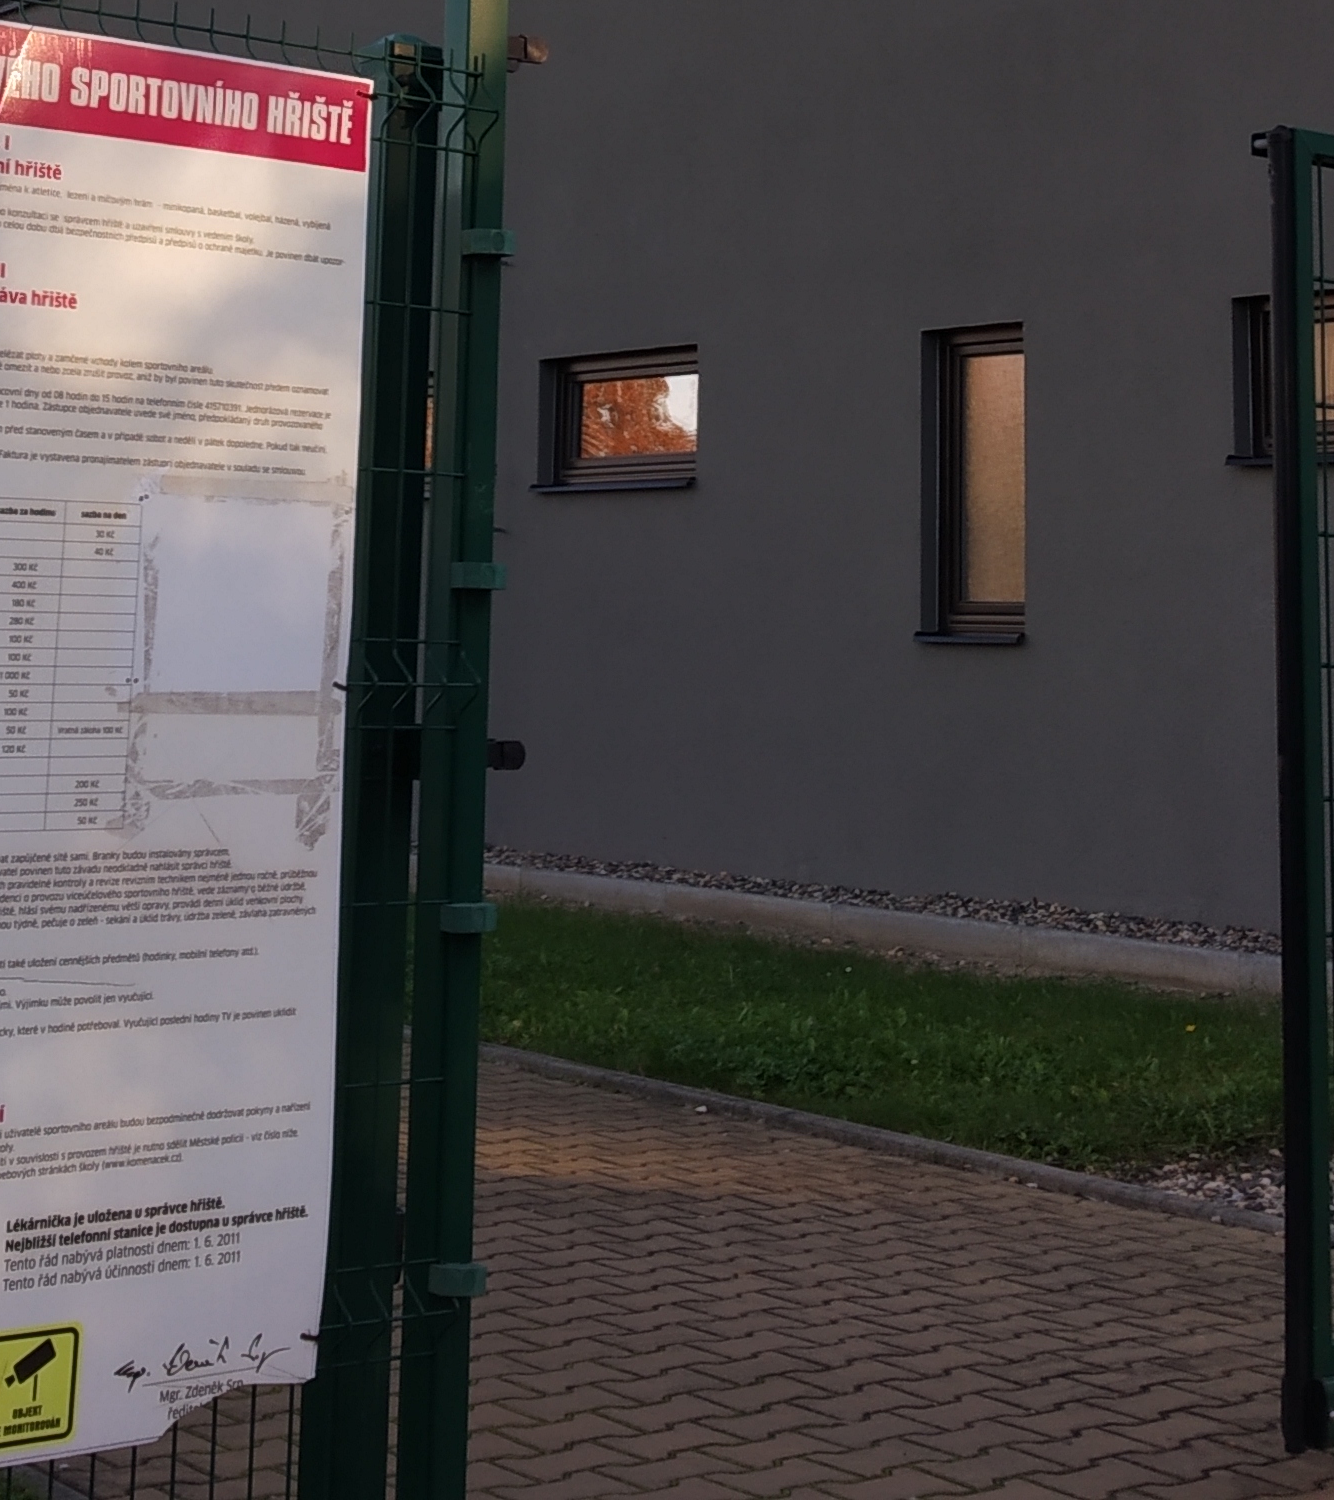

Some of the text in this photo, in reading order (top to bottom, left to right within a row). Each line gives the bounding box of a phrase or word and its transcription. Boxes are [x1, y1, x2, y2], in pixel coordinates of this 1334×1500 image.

[71, 67, 259, 132] SPORTOVNÍHO
[268, 91, 354, 145] HŘIŠTĚ
[4, 134, 10, 150] I
[14, 159, 61, 180] hřiště
[30, 289, 77, 309] hřiště
[4, 1204, 308, 1253] Nejbližší telefonní stanice je dostupna u správce hřiště.
[5, 1195, 225, 1233] Lékárnička je uložena u správce hřiště.
[3, 1231, 239, 1271] Tento řád nabývá platnosti dnem: 1. 6. 2011
[2, 1249, 240, 1291] Tento řád nabývá účinnosti dnem: 1. 6. 2011
[159, 1390, 181, 1403] Mgr.
[185, 1381, 223, 1399] Zdeněk
[12, 1405, 43, 1419] OBJEKT
